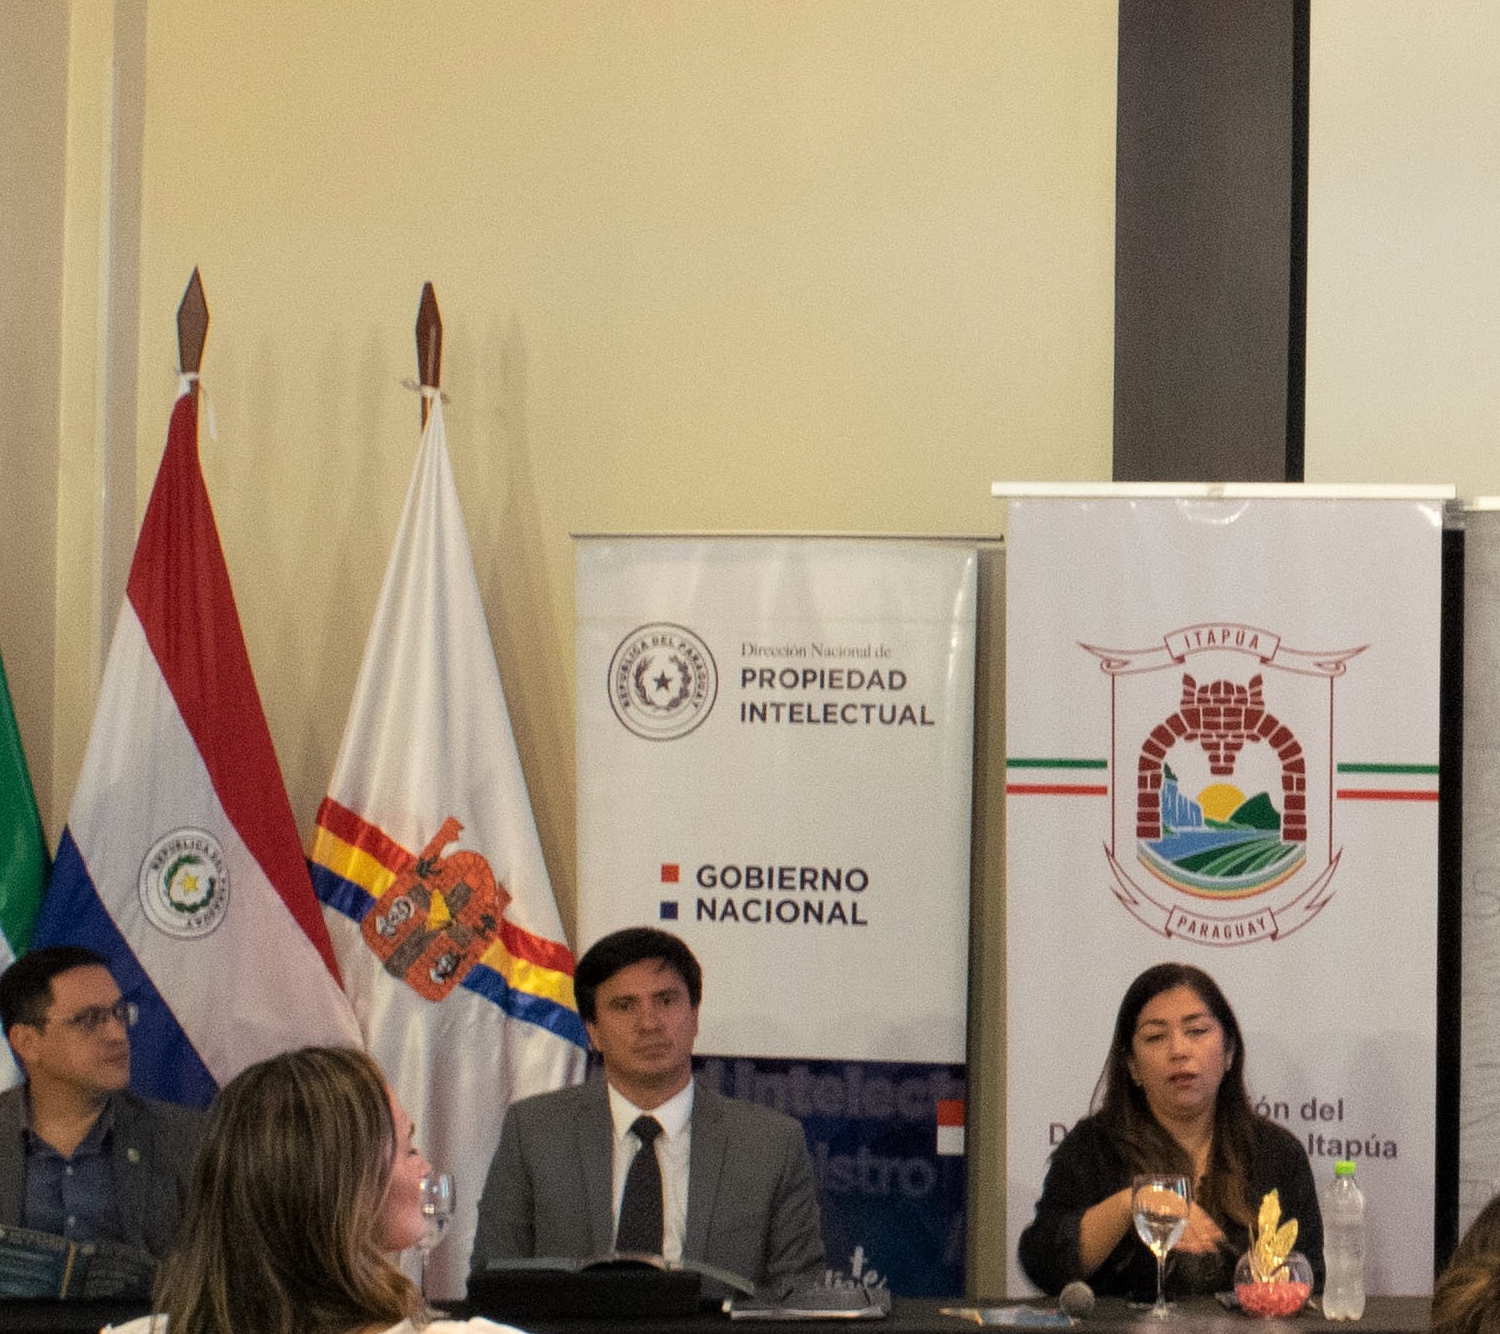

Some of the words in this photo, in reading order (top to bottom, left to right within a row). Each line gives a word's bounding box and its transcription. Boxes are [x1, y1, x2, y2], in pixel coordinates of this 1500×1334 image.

[740, 642, 807, 659] Dirección
[810, 642, 872, 659] Nacional
[875, 643, 892, 660] de
[740, 669, 907, 691] PROPIEDAD
[740, 702, 935, 727] INTELECTUAL
[695, 864, 869, 893] GOBIERNO
[695, 898, 868, 926] NACIONAL
[1177, 915, 1266, 940] PARAGUAY
[1300, 1097, 1345, 1121] del
[1308, 1133, 1398, 1161] Itapúa
